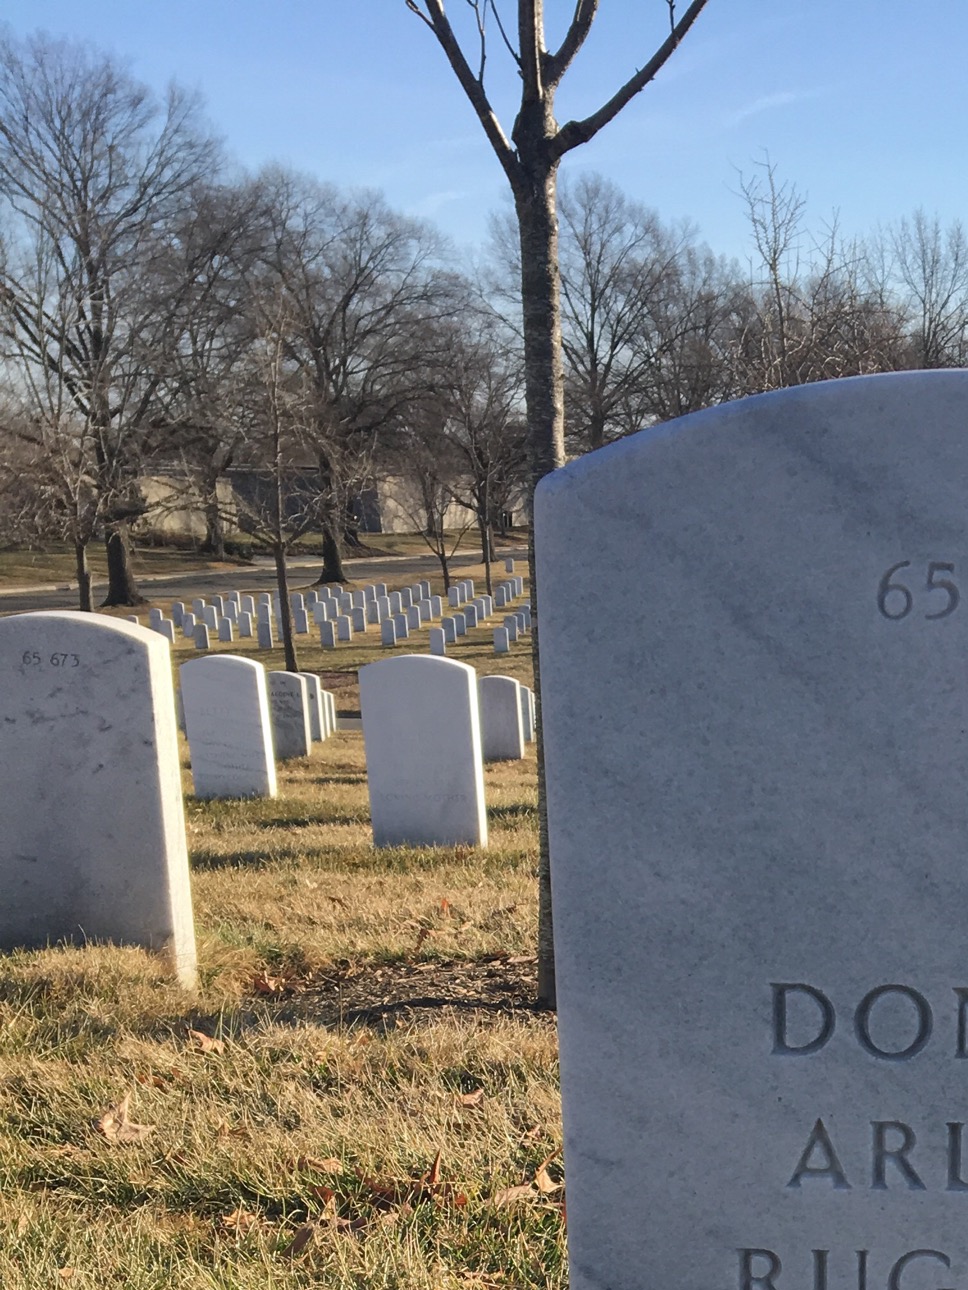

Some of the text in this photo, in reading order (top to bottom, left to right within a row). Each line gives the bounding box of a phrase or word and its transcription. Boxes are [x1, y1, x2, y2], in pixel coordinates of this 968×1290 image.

[877, 560, 960, 620] 65
[22, 651, 80, 668] 65 673
